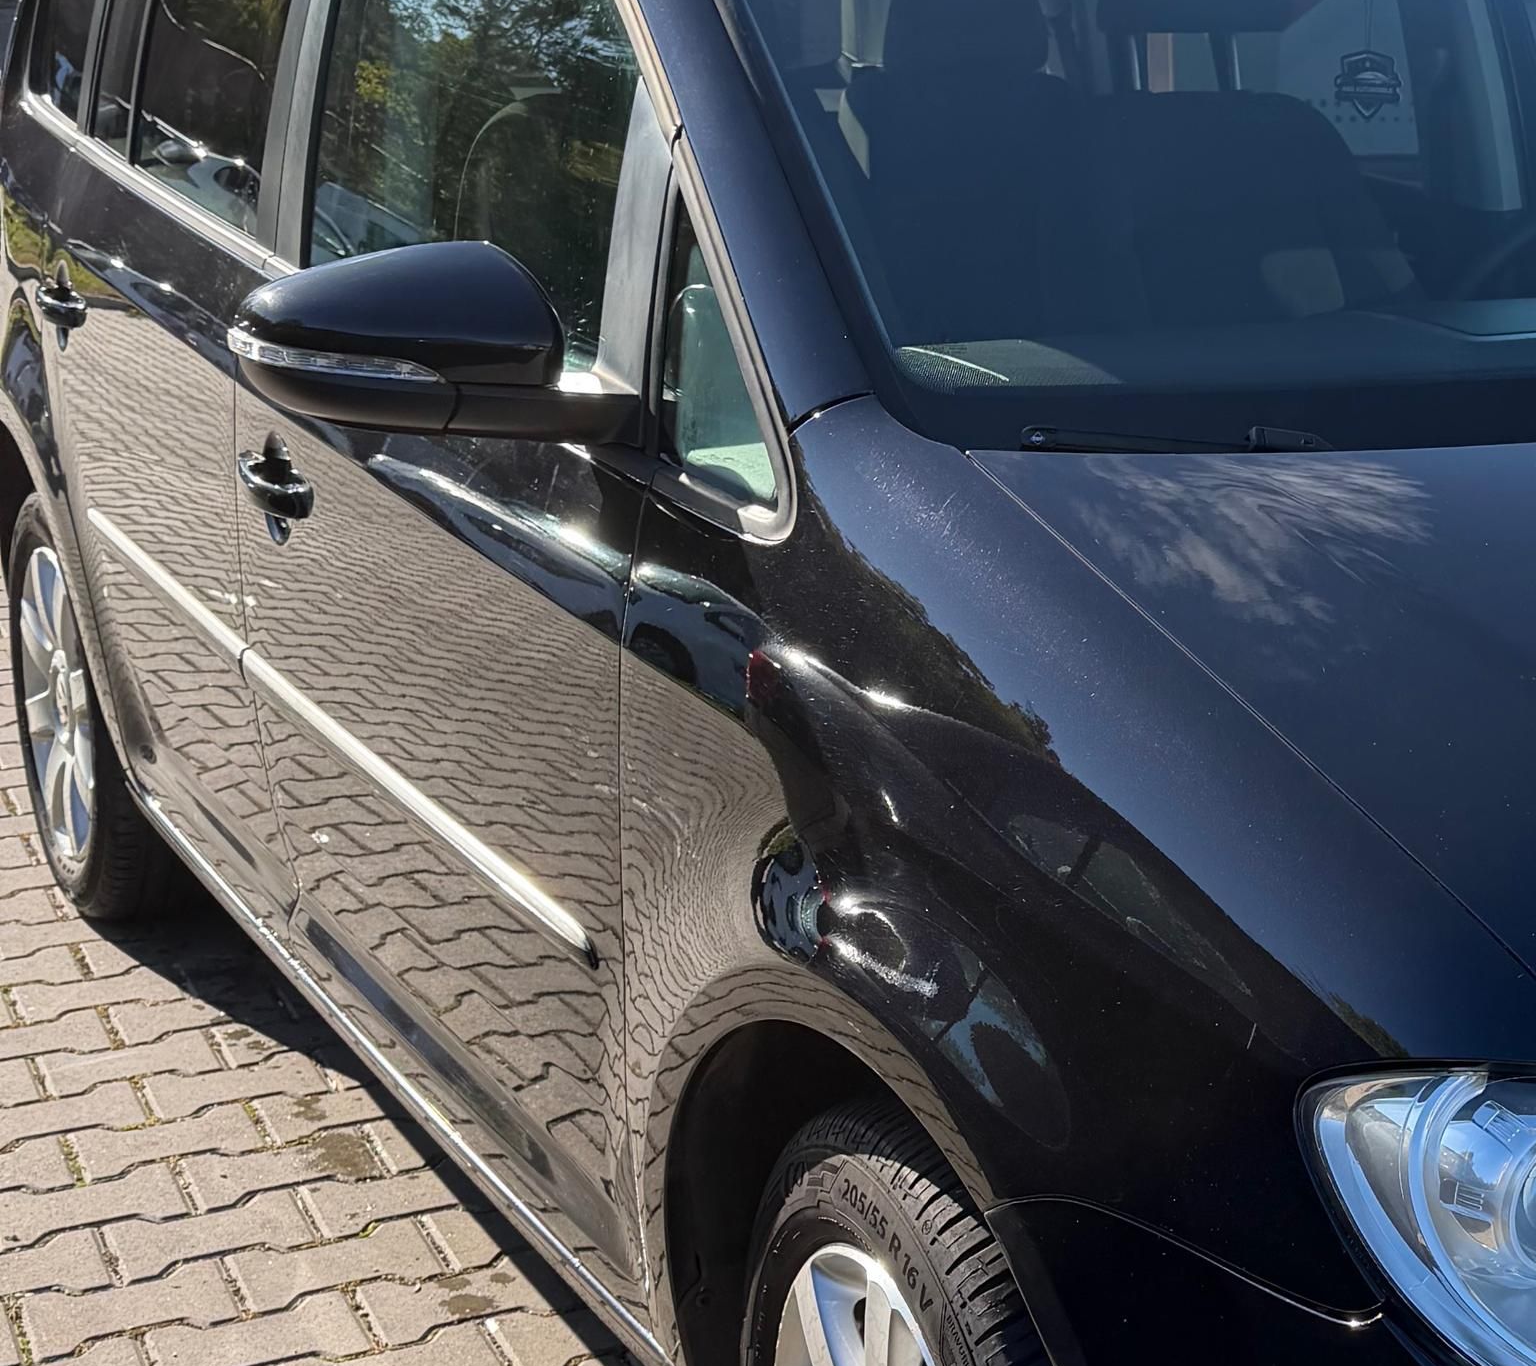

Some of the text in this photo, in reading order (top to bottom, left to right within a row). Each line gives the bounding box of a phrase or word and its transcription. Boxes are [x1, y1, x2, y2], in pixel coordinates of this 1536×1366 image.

[841, 1178, 934, 1312] 205/55 R 16 V
